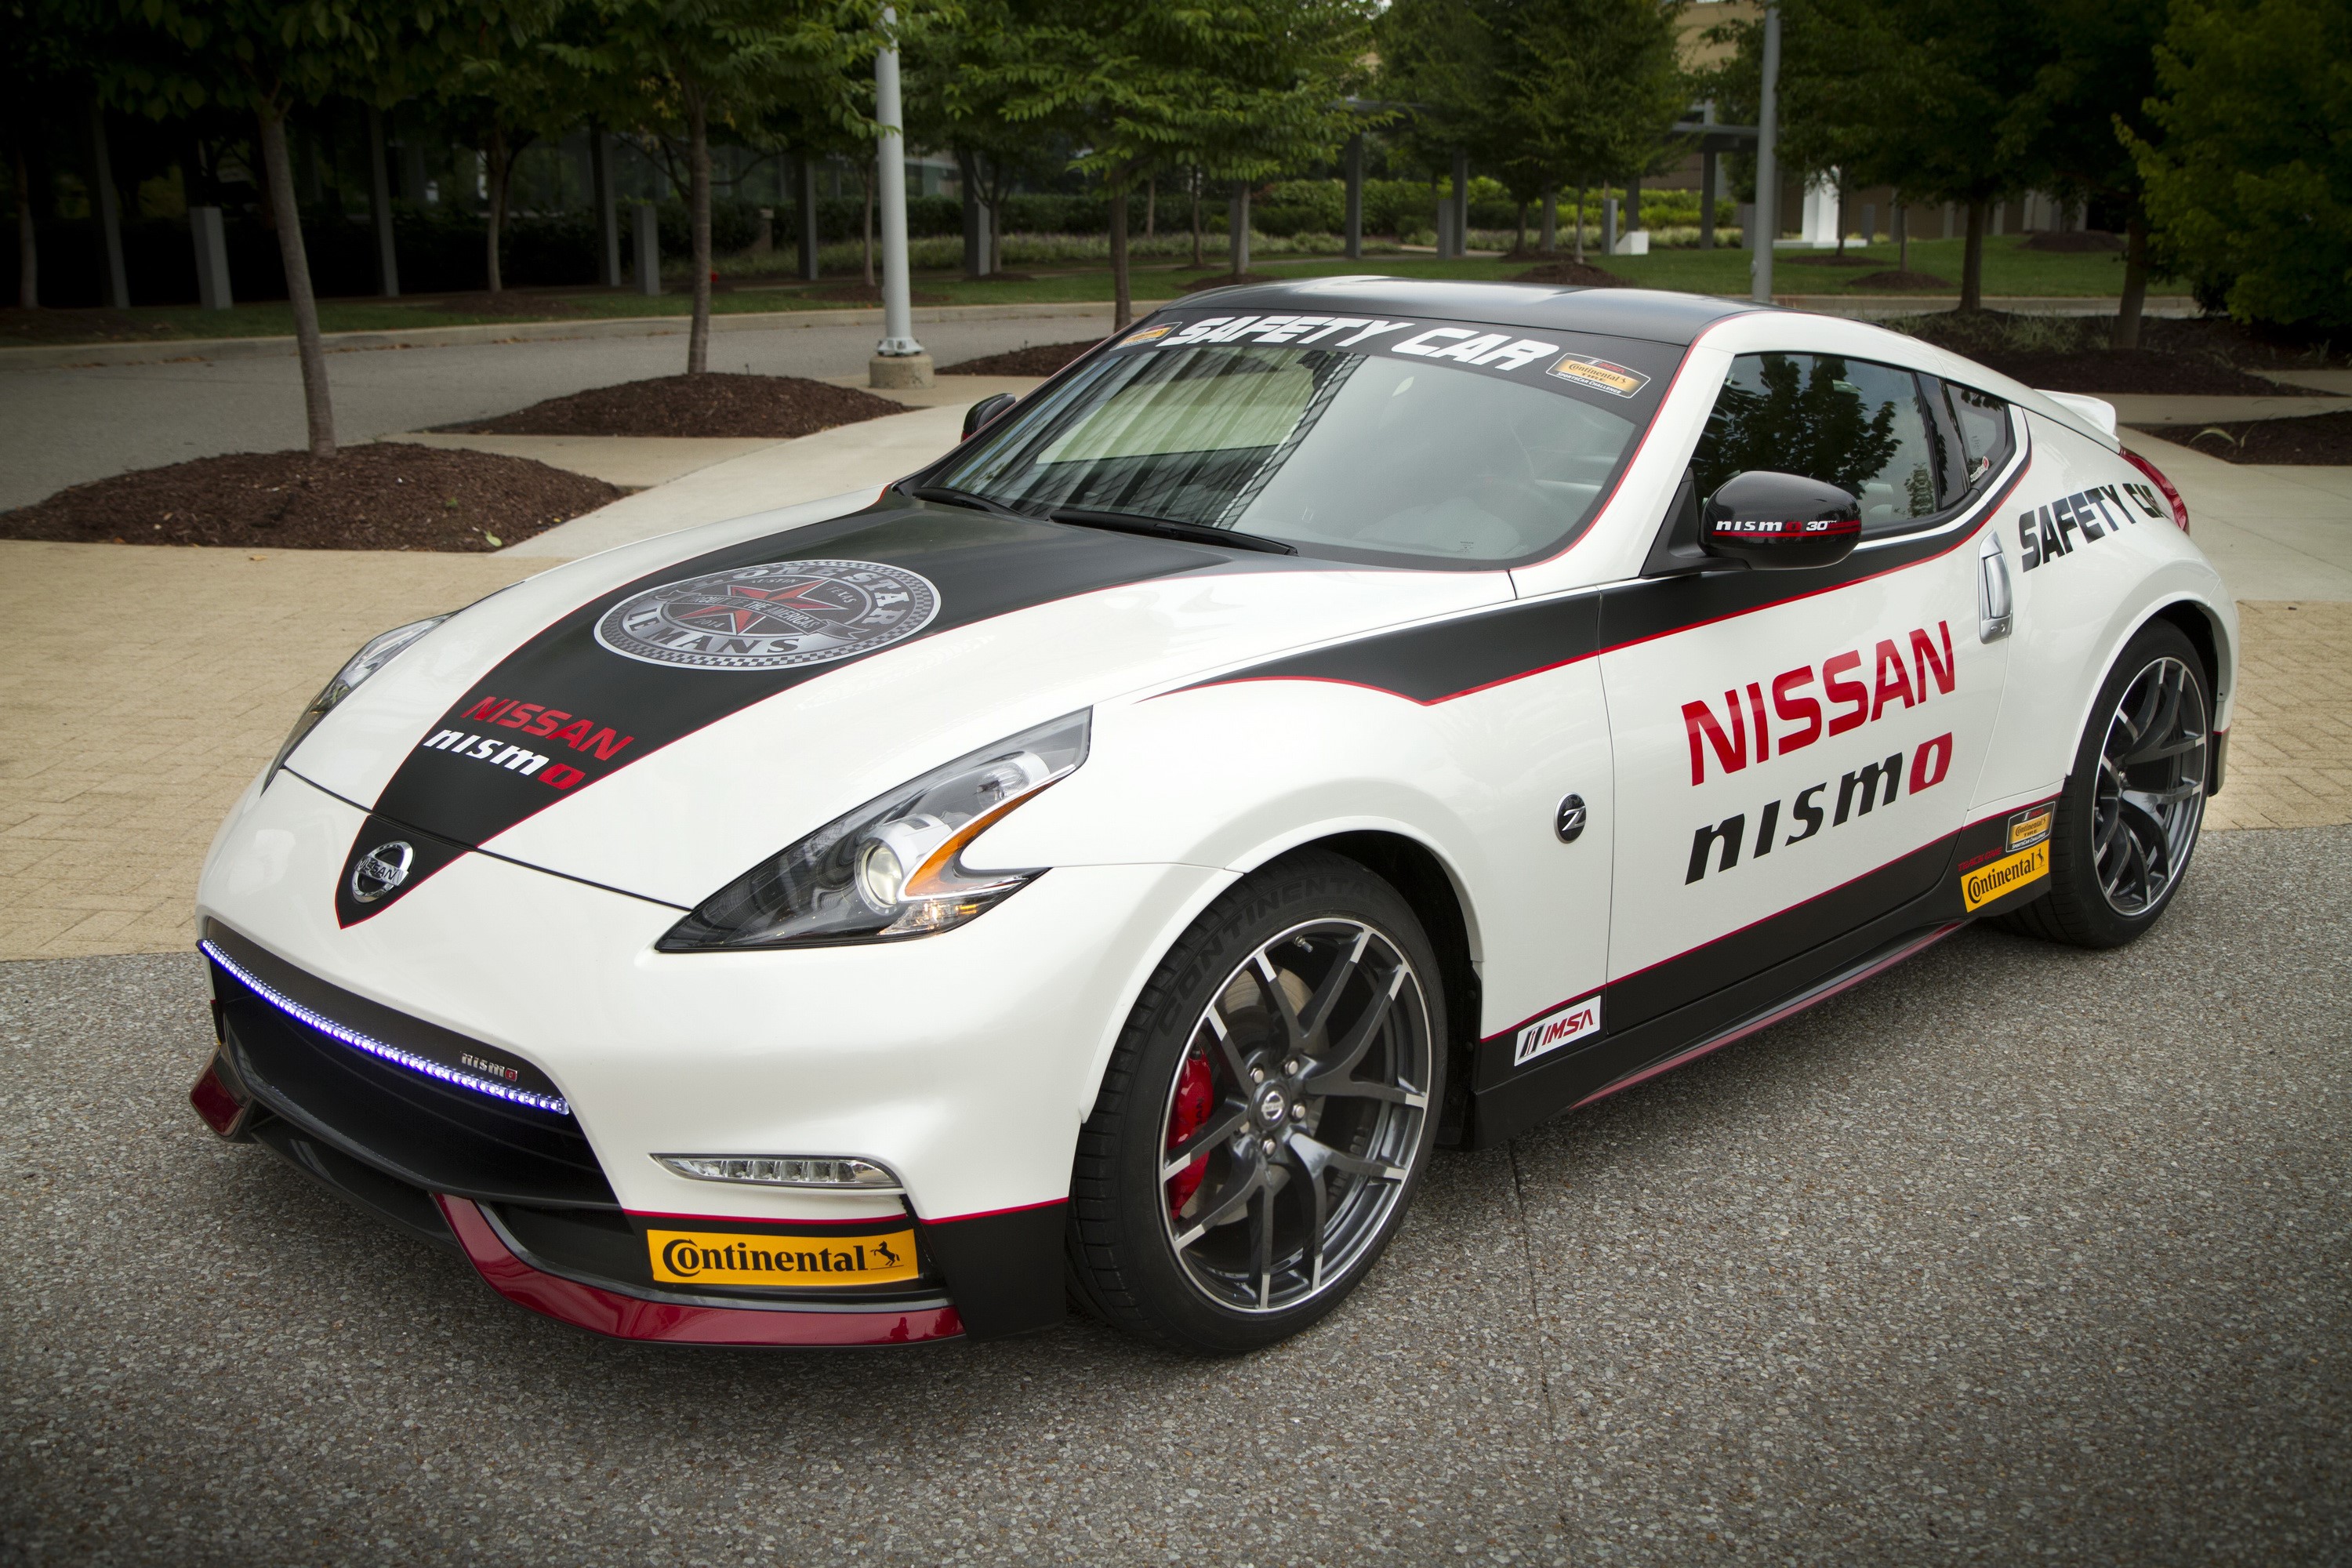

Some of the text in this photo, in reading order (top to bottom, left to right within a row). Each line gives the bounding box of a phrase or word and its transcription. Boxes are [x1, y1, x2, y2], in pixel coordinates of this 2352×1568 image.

[1156, 316, 1416, 347] SAFETY
[1392, 327, 1561, 371] CAR
[1568, 363, 1620, 381] Continental
[1715, 521, 1802, 532] nismo
[2019, 484, 2136, 573] SAFETY
[690, 565, 909, 625] LONE STAR
[744, 601, 772, 611] THE
[764, 606, 820, 629] AMERICAS
[826, 586, 856, 603] TEXAS
[628, 608, 800, 654] LE MANS
[695, 618, 725, 628] 2014
[1681, 620, 1955, 786] NISSAN
[460, 696, 634, 760] NISSAN
[423, 728, 586, 790] nismo
[1685, 732, 1952, 885] nismo
[358, 857, 397, 880] NISSAN
[1968, 852, 2035, 904] Continental
[1541, 1008, 1594, 1046] IMSA
[462, 1053, 518, 1082] nismo
[662, 1239, 868, 1277] Continental
